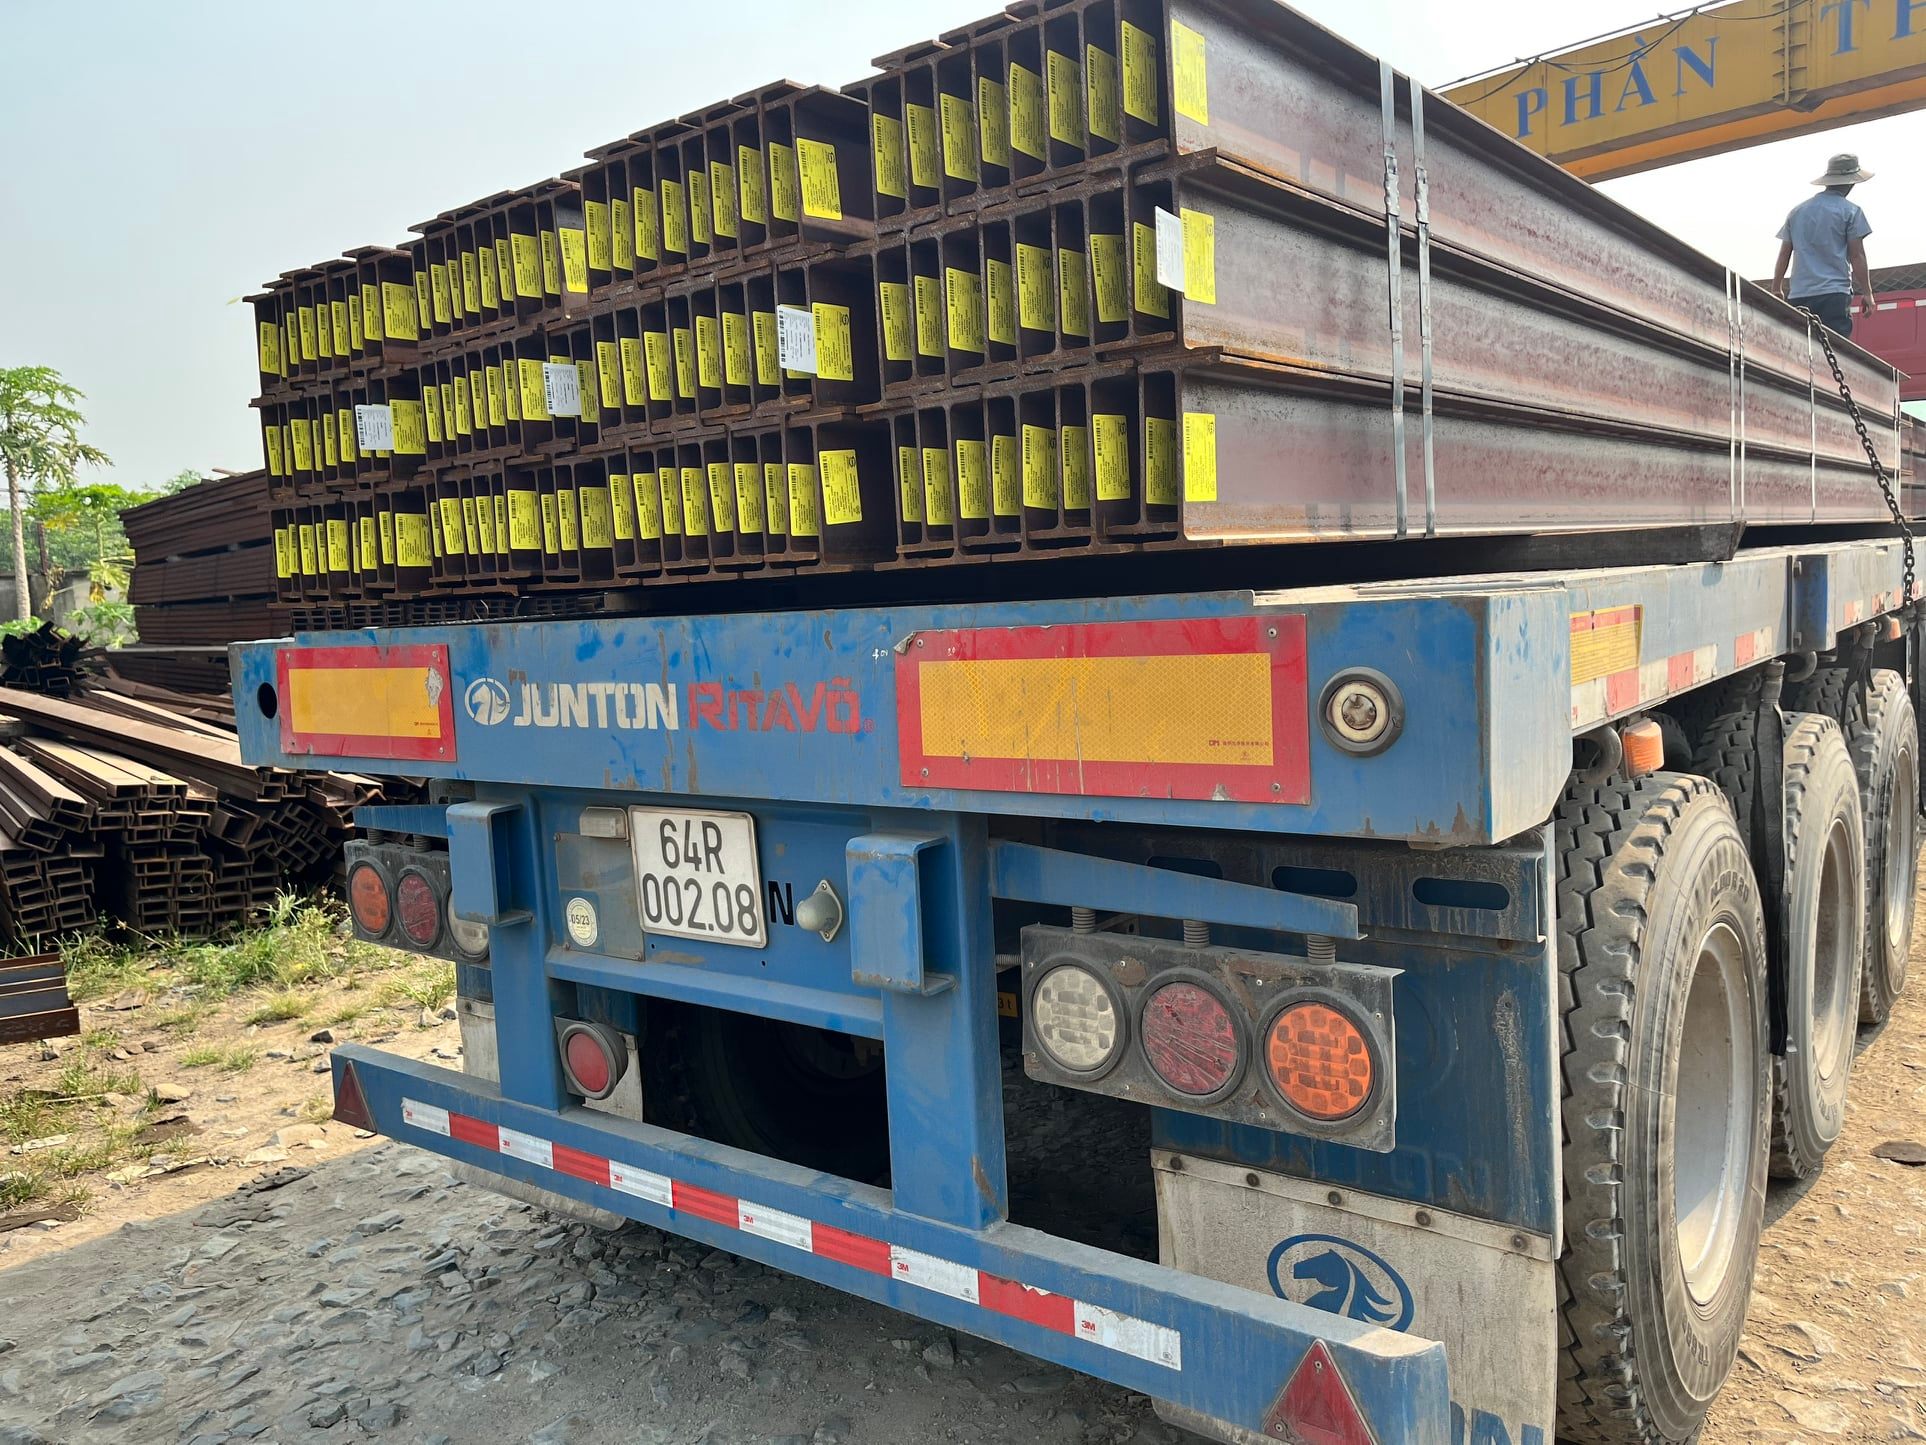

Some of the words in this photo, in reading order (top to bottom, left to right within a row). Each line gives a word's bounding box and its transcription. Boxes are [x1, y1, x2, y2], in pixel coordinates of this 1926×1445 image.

[1513, 35, 1718, 138] PHẦN
[513, 682, 679, 730] JUNTON
[659, 818, 725, 874] 64R
[642, 872, 758, 936] 002.08
[571, 914, 590, 926] 05/23
[743, 1215, 754, 1224] 3M
[896, 1262, 909, 1273] 3M
[1081, 1320, 1096, 1331] 3M
